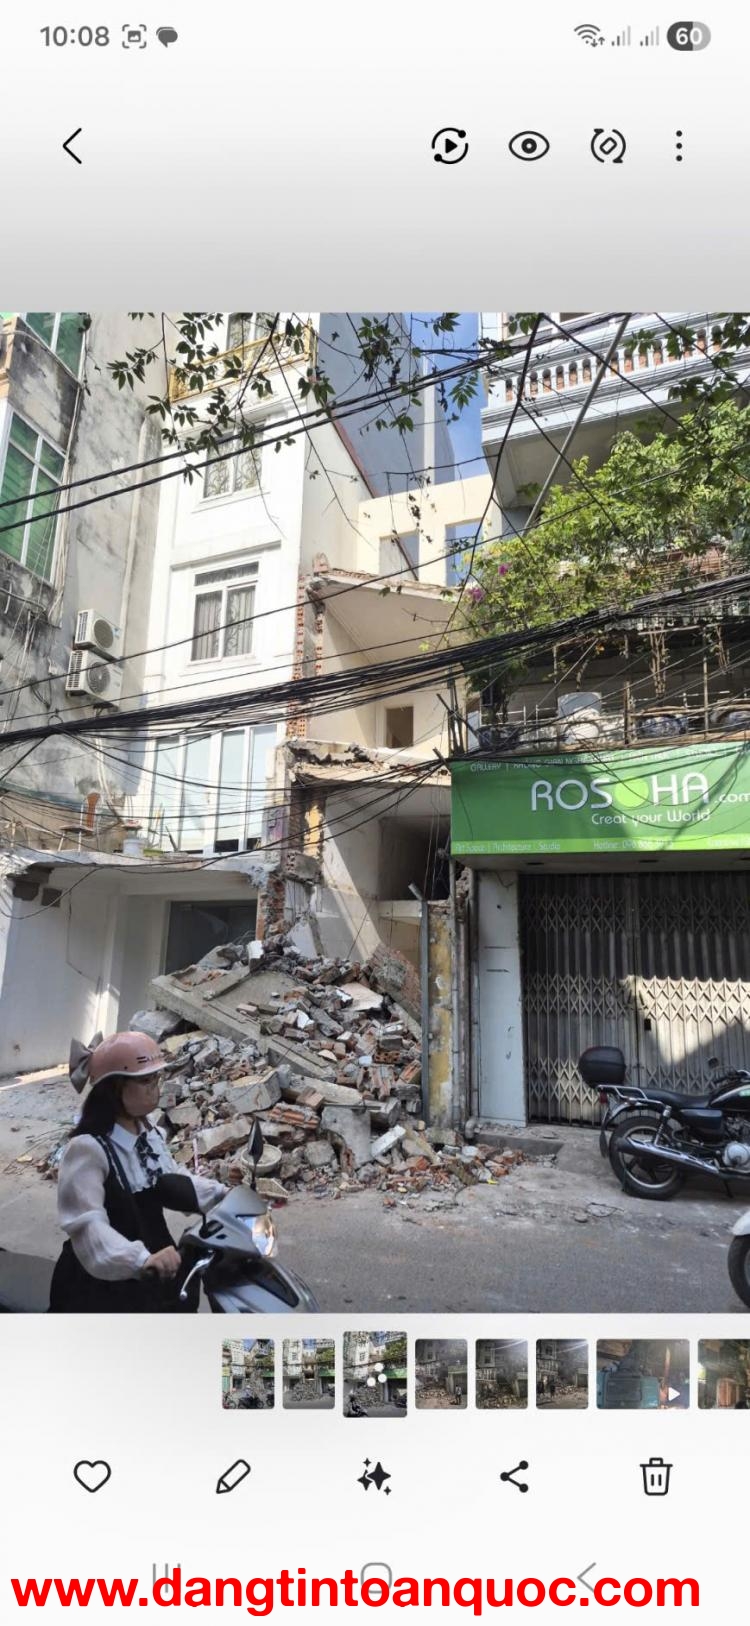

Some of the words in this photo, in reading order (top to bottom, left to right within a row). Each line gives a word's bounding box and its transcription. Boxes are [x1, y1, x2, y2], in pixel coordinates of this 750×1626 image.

[39, 25, 110, 48] 10:08
[675, 27, 703, 46] 60
[591, 813, 627, 824] Creat
[632, 813, 662, 827] your
[666, 809, 711, 822] World
